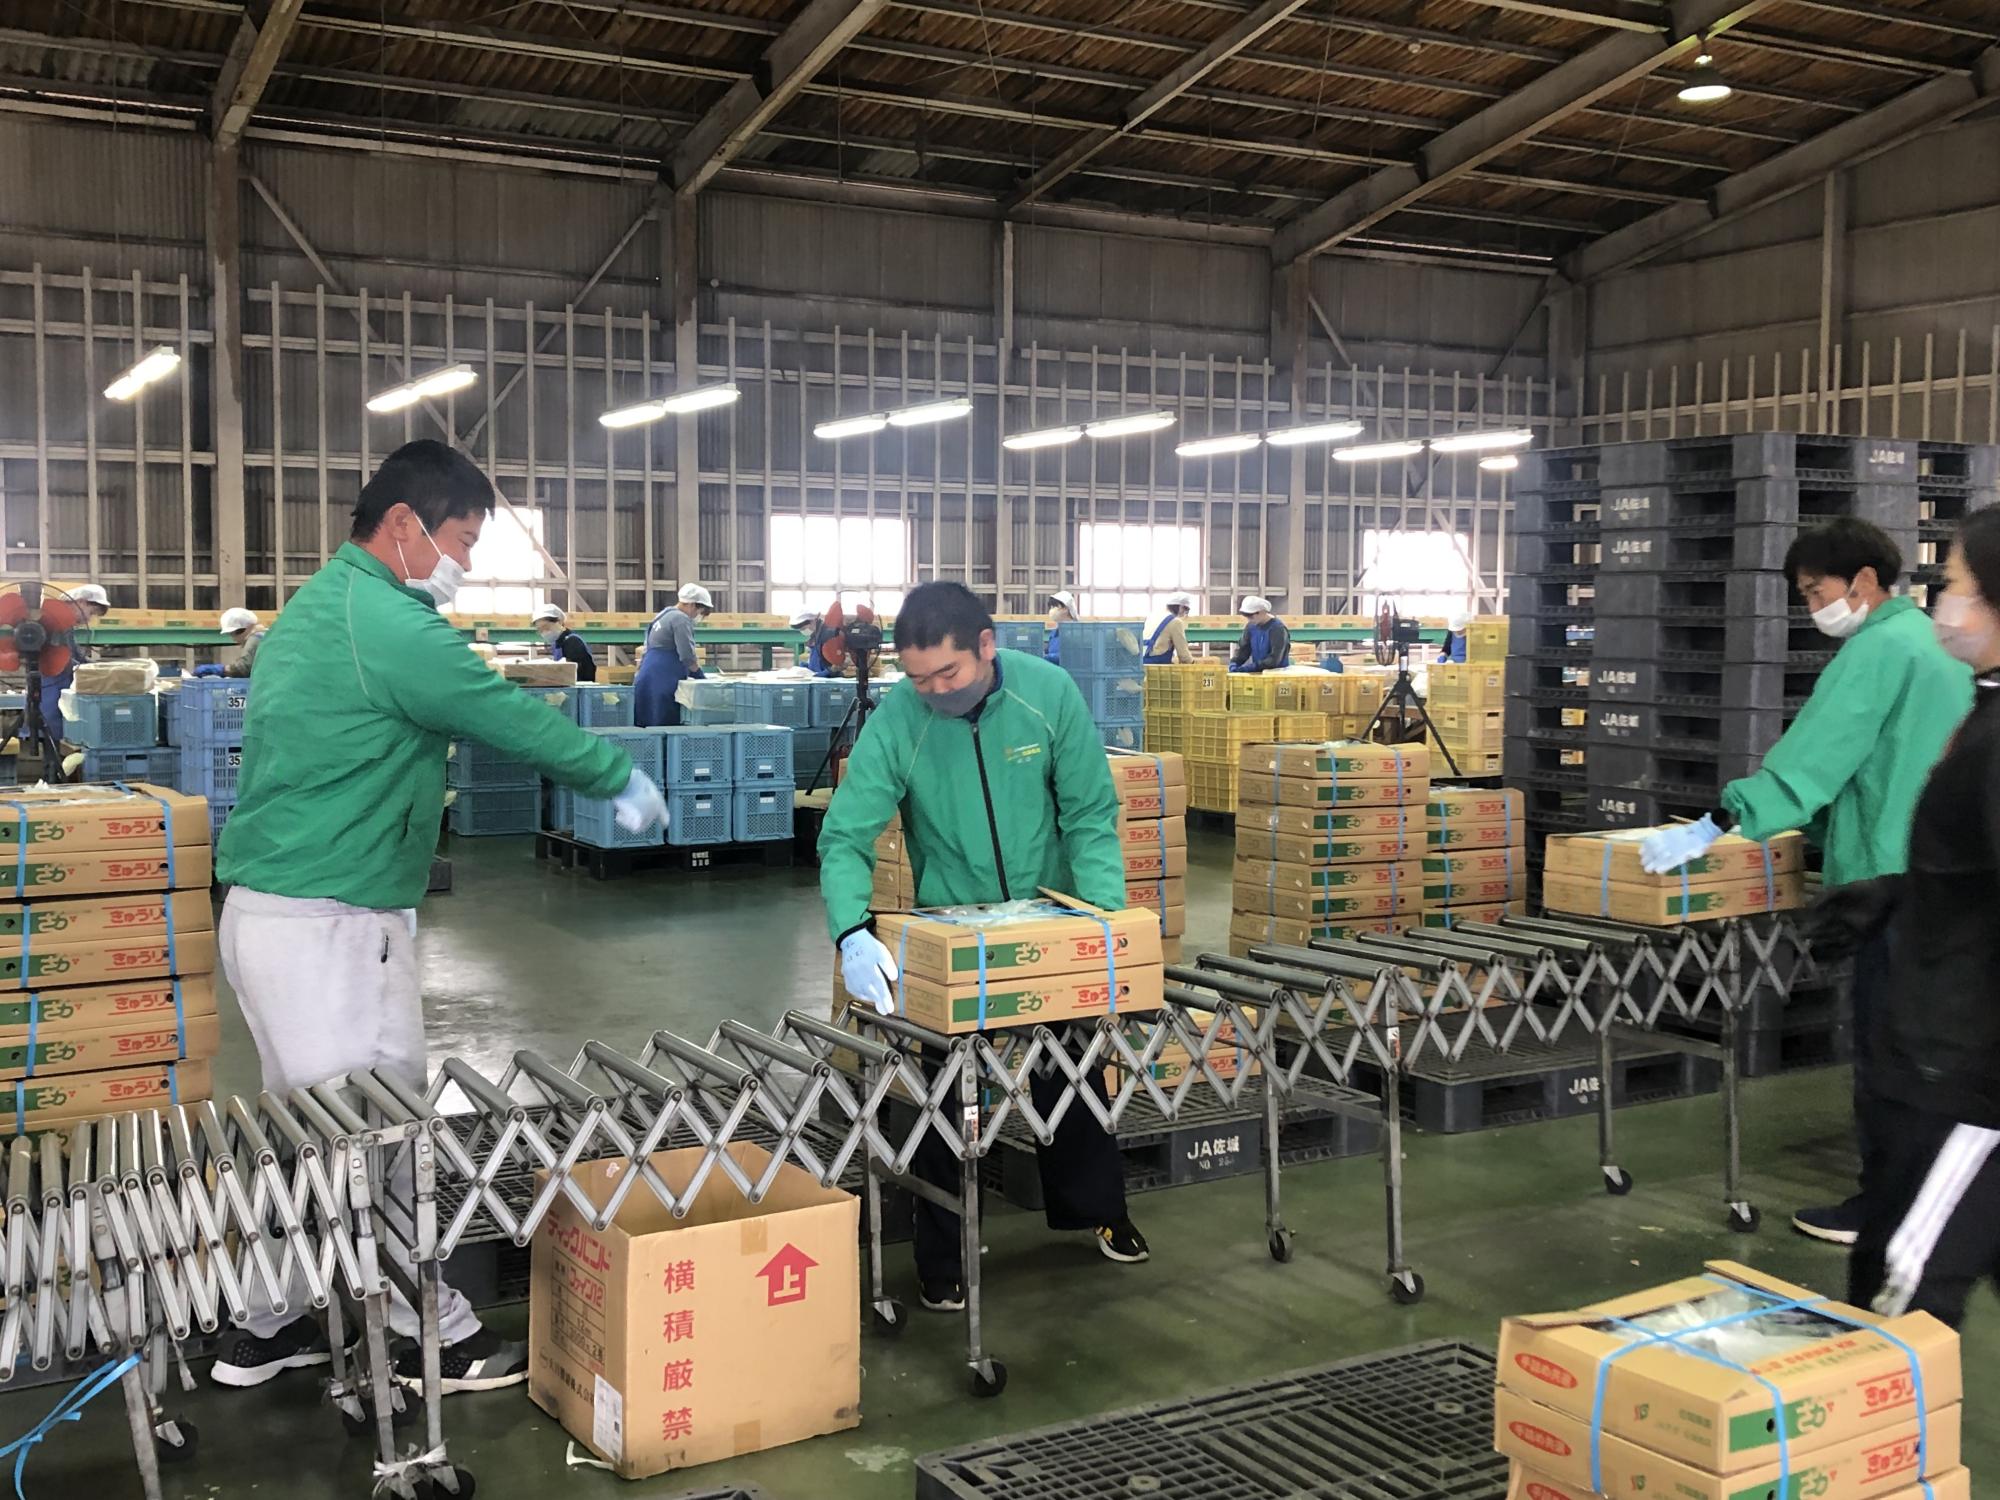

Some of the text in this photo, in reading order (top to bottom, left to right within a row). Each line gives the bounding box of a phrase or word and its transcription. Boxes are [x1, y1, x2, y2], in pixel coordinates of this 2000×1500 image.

[228, 697, 246, 708] 357
[228, 755, 241, 766] 35
[107, 821, 161, 835] きゅうり
[108, 863, 162, 877] きゅうり
[110, 907, 163, 924] きゅうり
[112, 950, 165, 967] きゅうり
[115, 992, 168, 1010] きゅうり
[117, 1033, 171, 1051] きゅうり
[109, 1080, 162, 1098] きゅうり
[773, 1264, 801, 1299] 上
[661, 1259, 696, 1441] 横積厳禁
